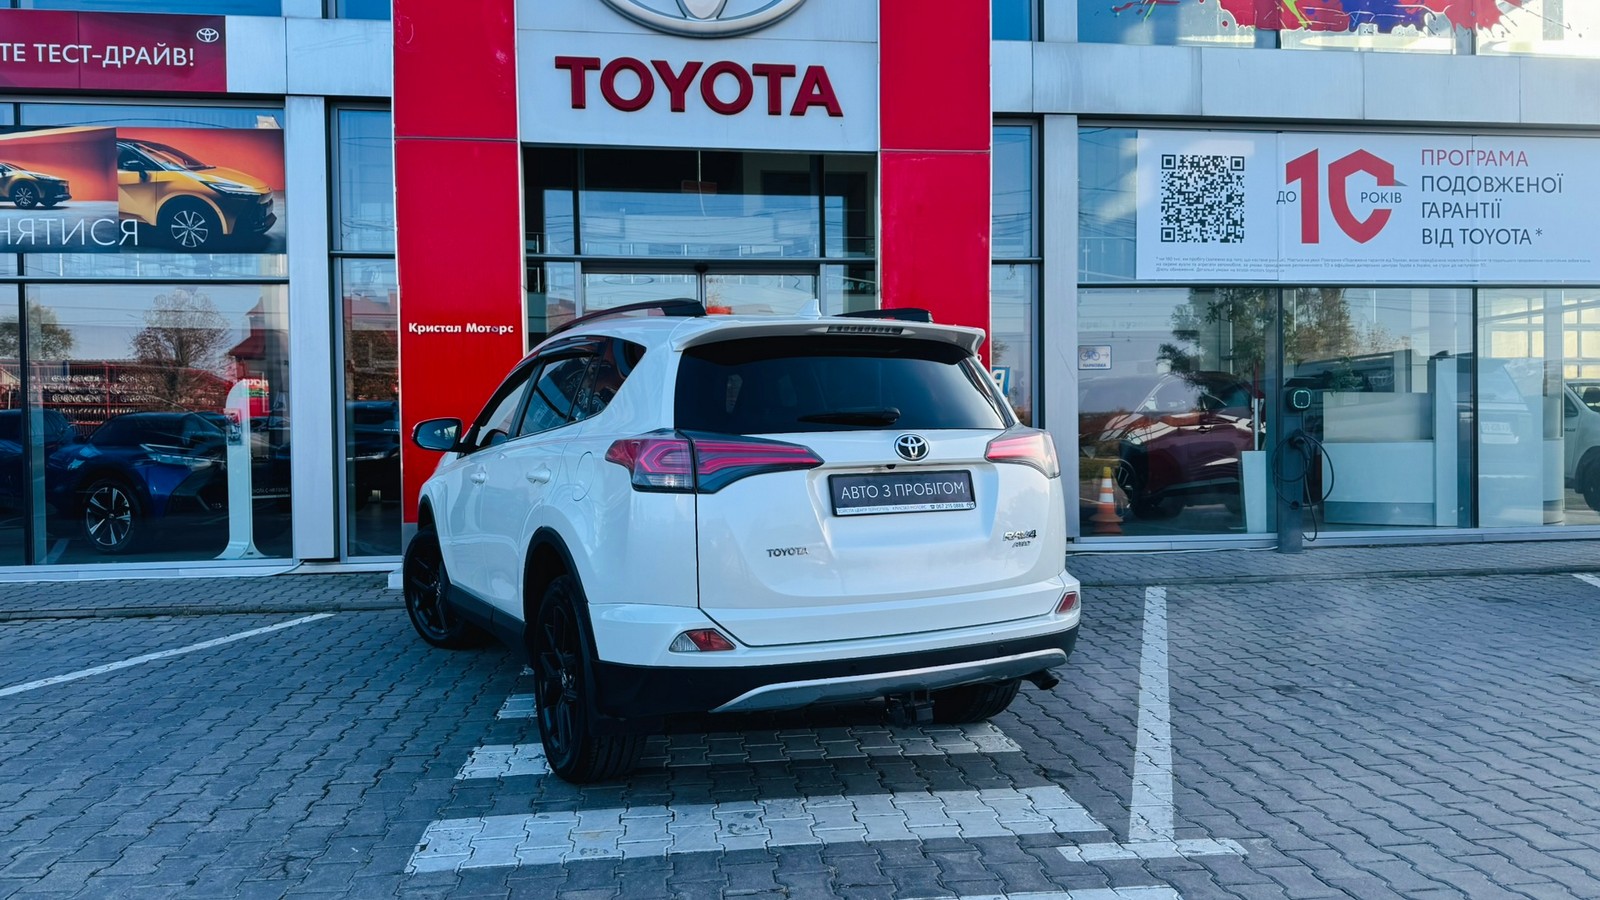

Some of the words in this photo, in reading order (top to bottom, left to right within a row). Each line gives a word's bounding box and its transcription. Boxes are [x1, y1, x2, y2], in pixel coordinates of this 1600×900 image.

[33, 43, 195, 68] ТЕСТ-ДРАЙВ!
[554, 55, 843, 117] TOYOTA
[1421, 149, 1529, 167] ПРОГРАМА
[1421, 173, 1564, 196] ПОДОВЖЕНОЇ
[1276, 190, 1297, 205] ДО
[1360, 191, 1402, 204] РОКІВ
[1421, 198, 1502, 219] ГАРАНТІЇ
[1422, 228, 1454, 248] ВІД
[408, 322, 462, 335] Кристал
[465, 322, 514, 335] Моторс
[841, 484, 879, 500] АВТО
[894, 481, 965, 497] ПРОБІГОМ
[766, 547, 809, 558] TOYOTA
